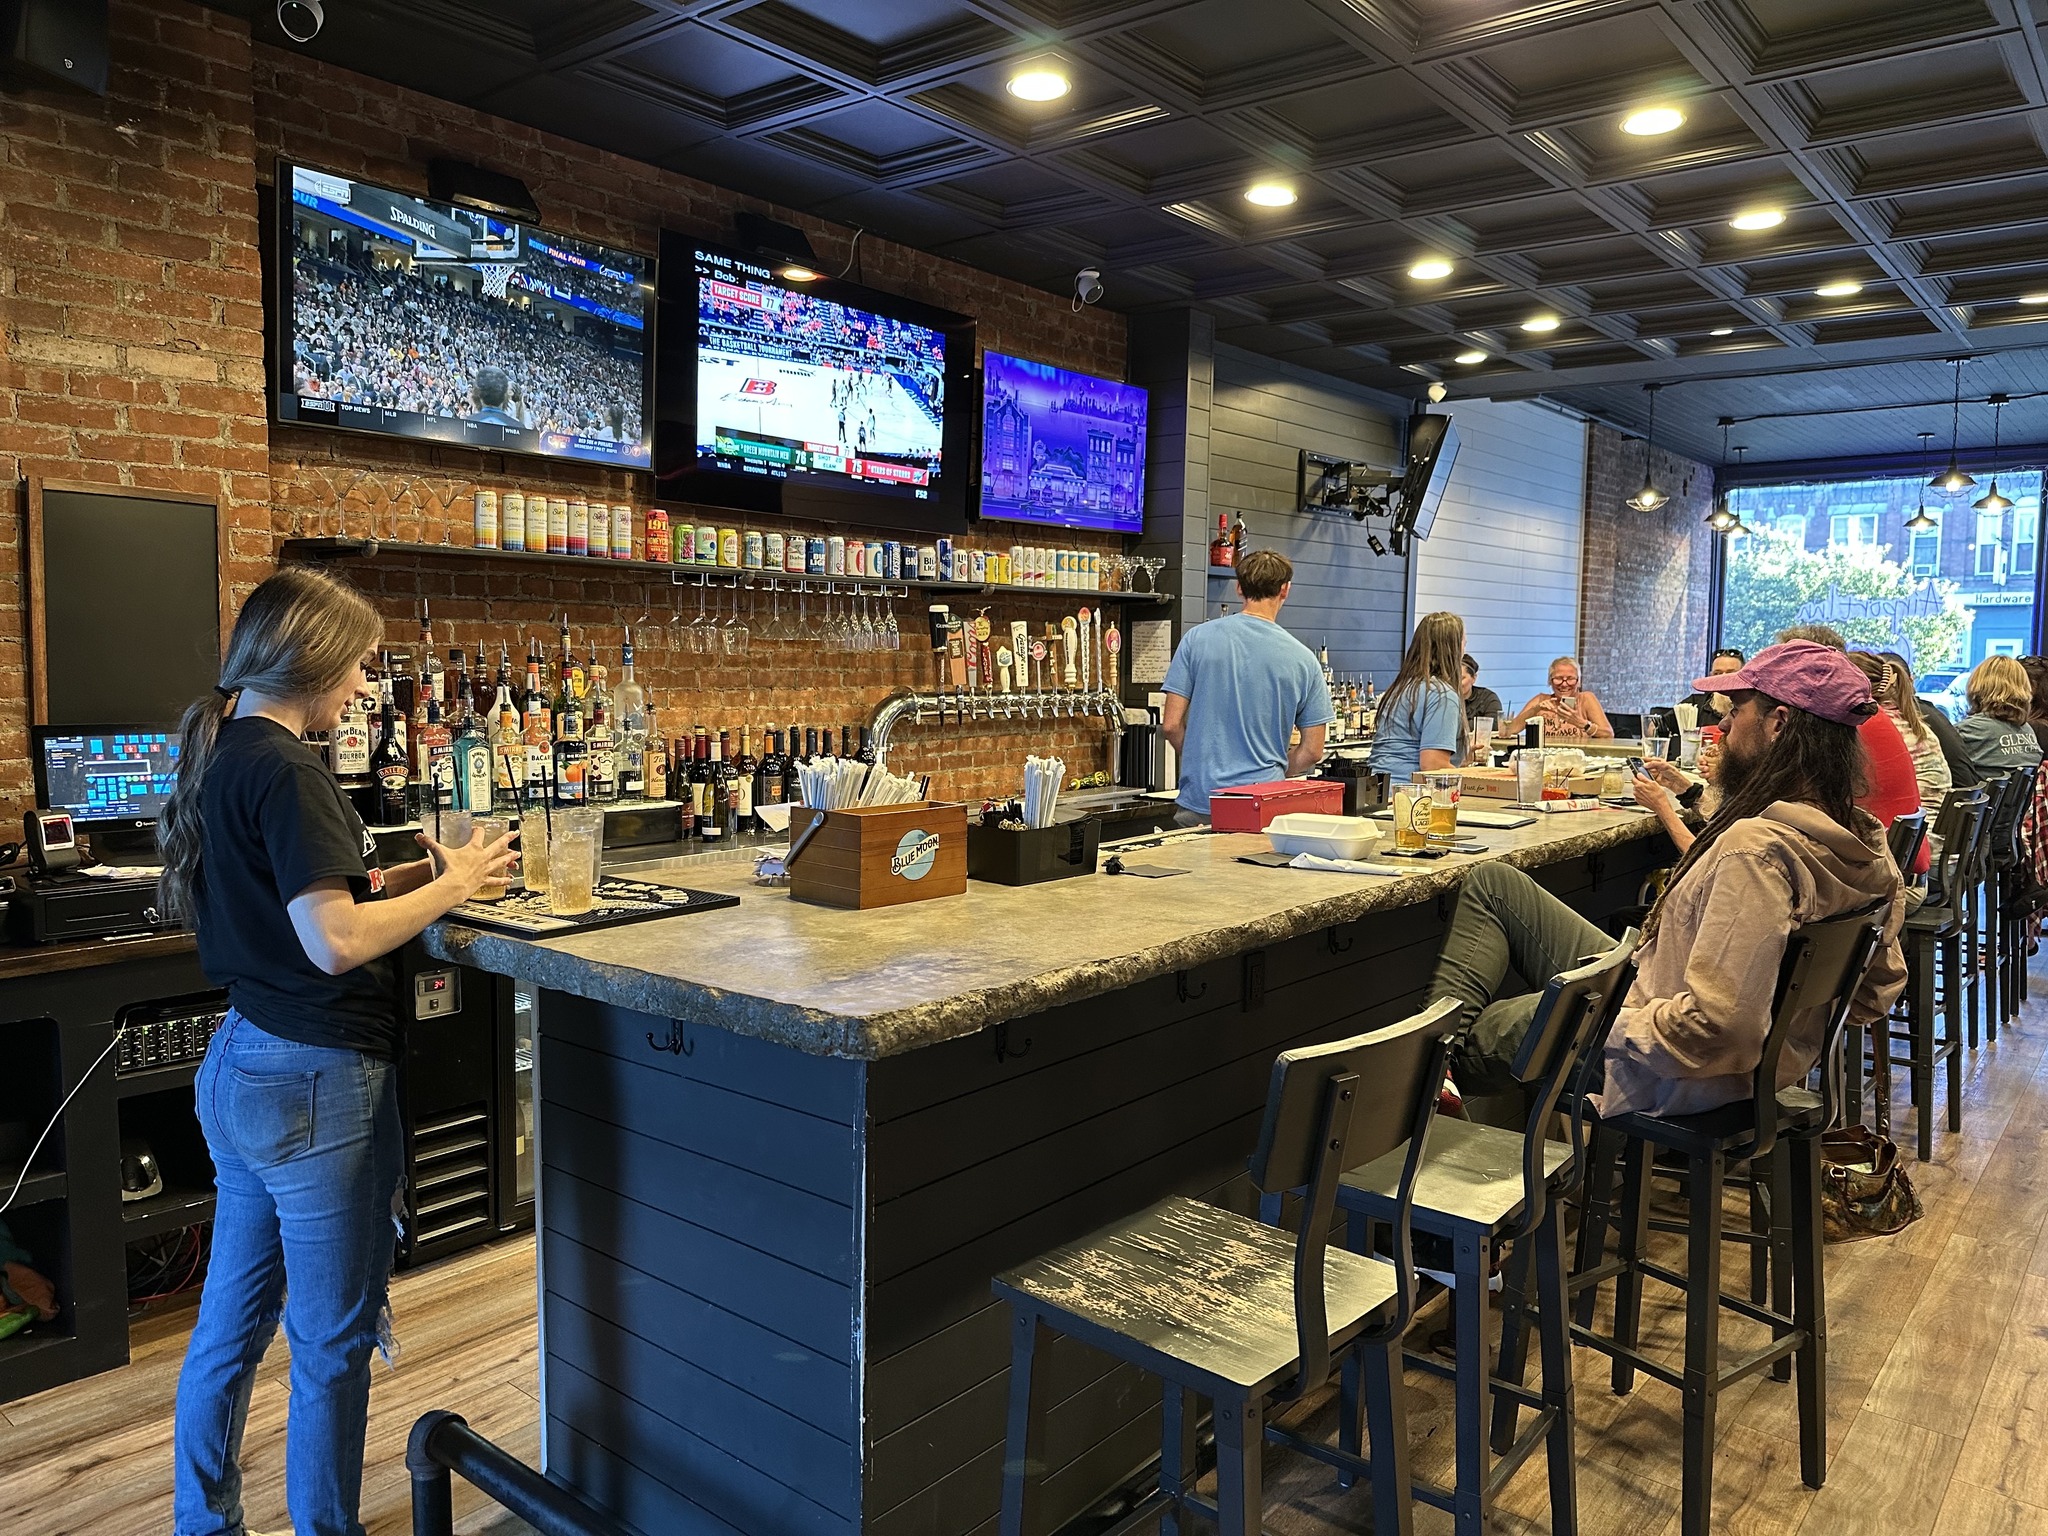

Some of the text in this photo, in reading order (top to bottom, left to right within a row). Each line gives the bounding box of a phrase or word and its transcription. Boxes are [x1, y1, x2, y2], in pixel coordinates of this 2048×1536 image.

[390, 205, 437, 240] SPALDING
[548, 247, 567, 261] FINAL
[568, 255, 586, 267] FOUR
[695, 250, 775, 281] SAME THING.
[714, 269, 739, 284] Bob:
[714, 284, 738, 299] TARGET
[739, 292, 760, 305] SCORE
[709, 336, 793, 357] THE BASKETBALL TOURNAMENT
[354, 405, 371, 414] NEWS
[795, 450, 807, 465] 76
[851, 460, 862, 473] 75
[915, 489, 928, 500] FS2
[1975, 594, 2032, 604] Hardware
[336, 727, 366, 740] JIM BEAM
[340, 752, 366, 760] BOURBON
[2001, 746, 2023, 756] WINE
[379, 766, 408, 776] BAILEYS
[1476, 784, 1485, 792] for
[893, 836, 938, 873] BLUE MOON
